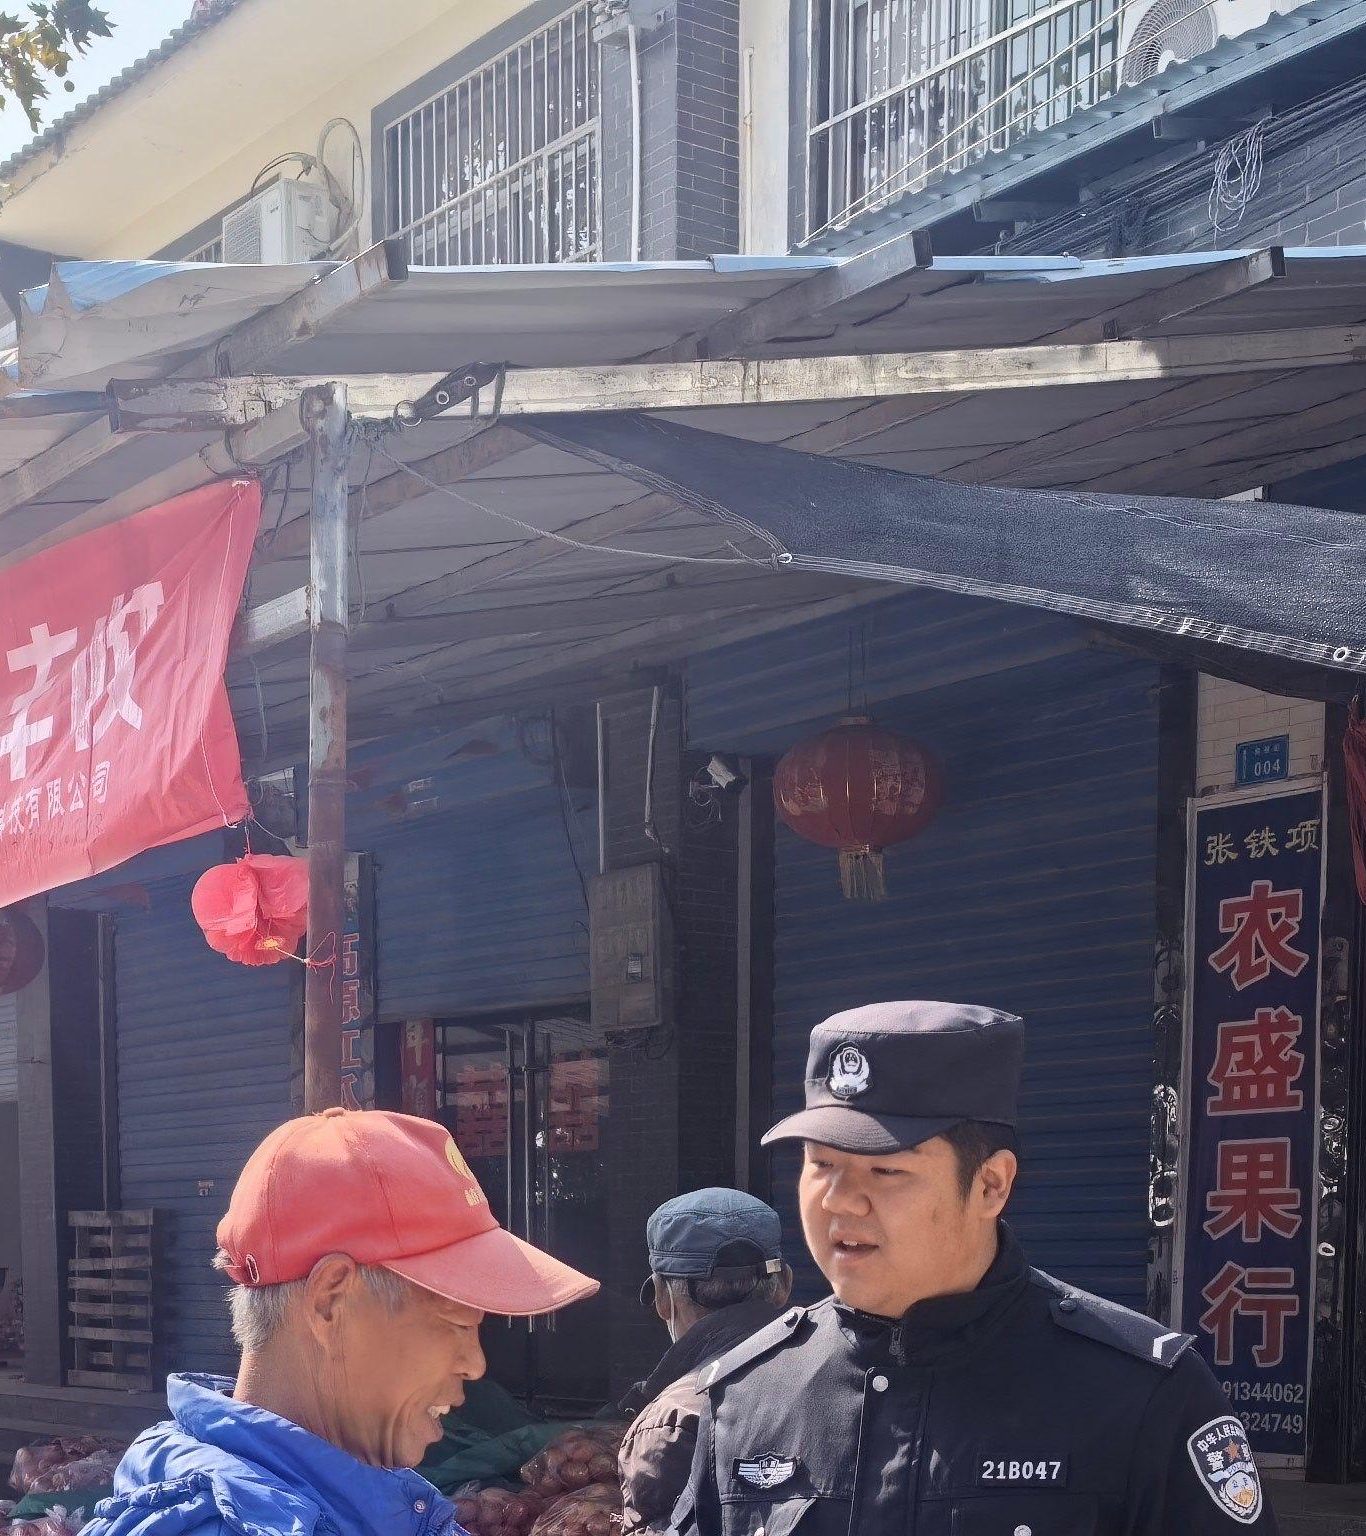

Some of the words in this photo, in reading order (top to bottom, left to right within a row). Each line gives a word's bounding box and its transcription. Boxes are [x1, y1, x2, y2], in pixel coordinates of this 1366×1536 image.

[1199, 879, 1310, 1371] 农盛果行
[981, 1460, 1061, 1480] 21B047
